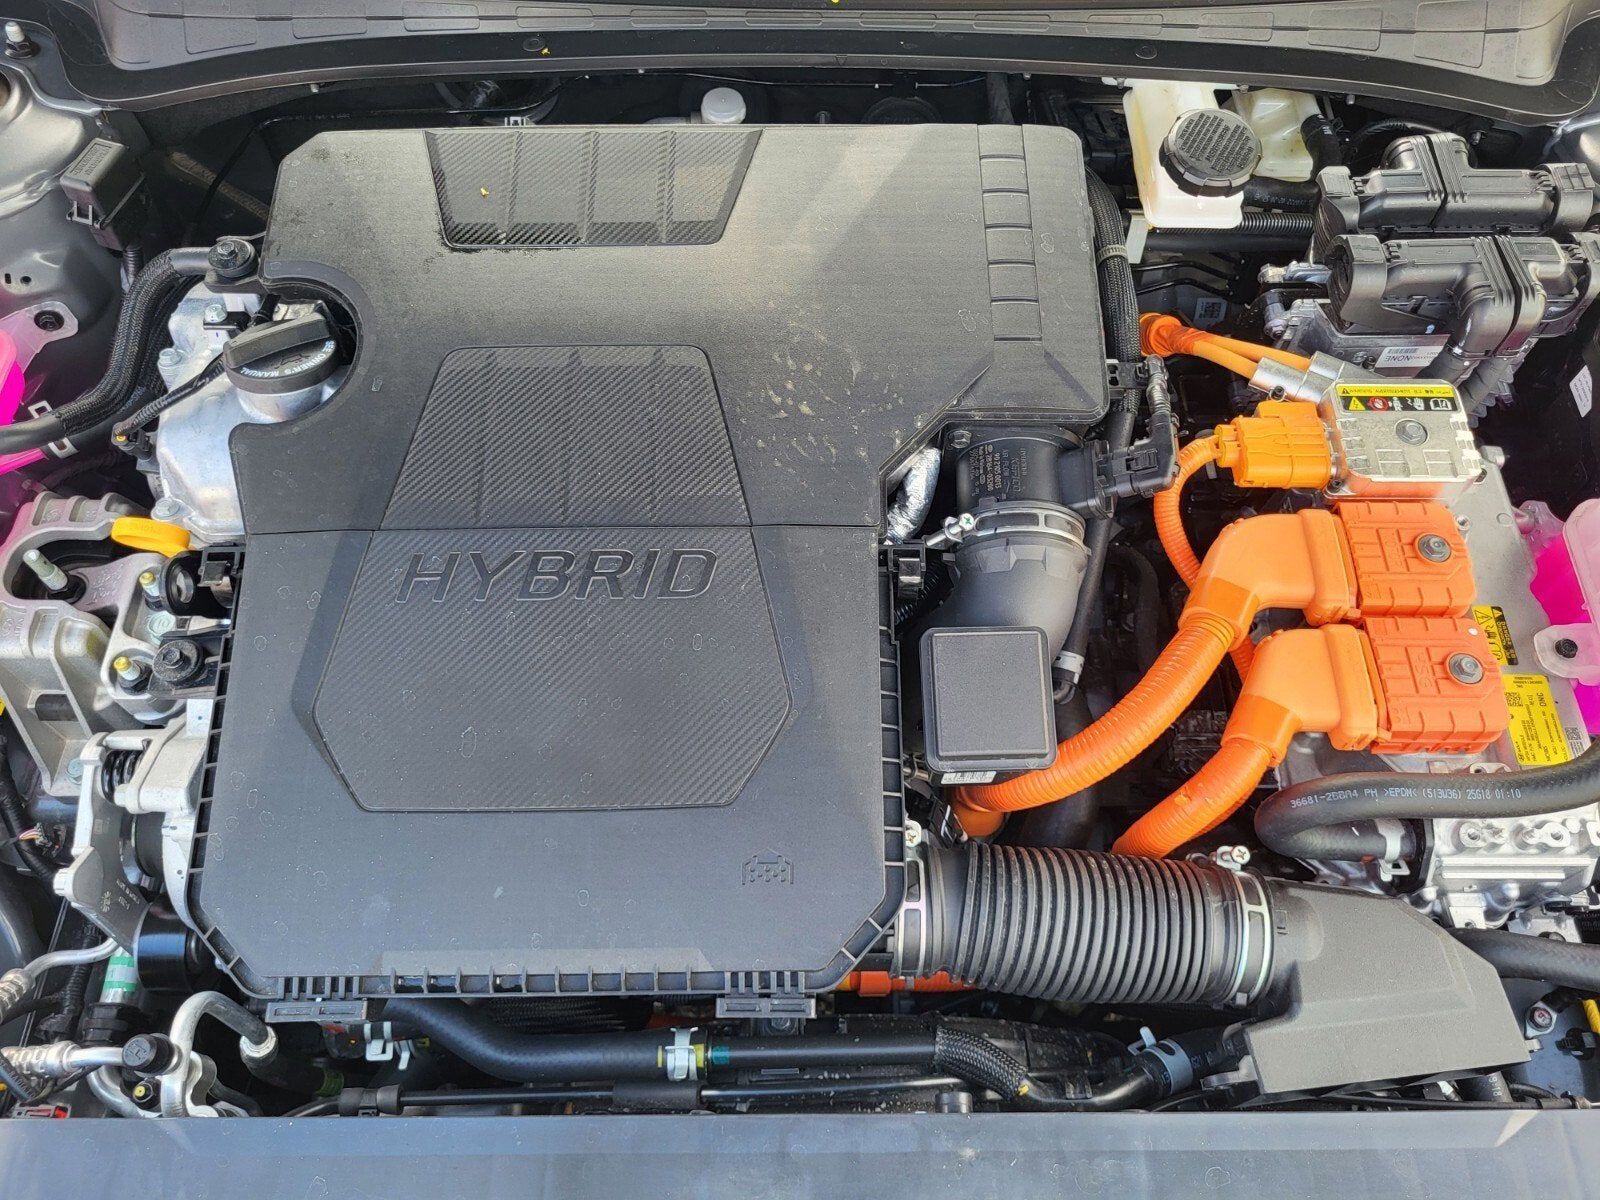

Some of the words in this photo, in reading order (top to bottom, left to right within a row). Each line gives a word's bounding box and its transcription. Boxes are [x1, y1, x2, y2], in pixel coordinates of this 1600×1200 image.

[322, 340, 335, 353] SEE
[284, 353, 326, 375] OWNER'S
[240, 367, 280, 377] MANUAL
[395, 548, 718, 604] HYBRID
[1364, 788, 1378, 797] PH
